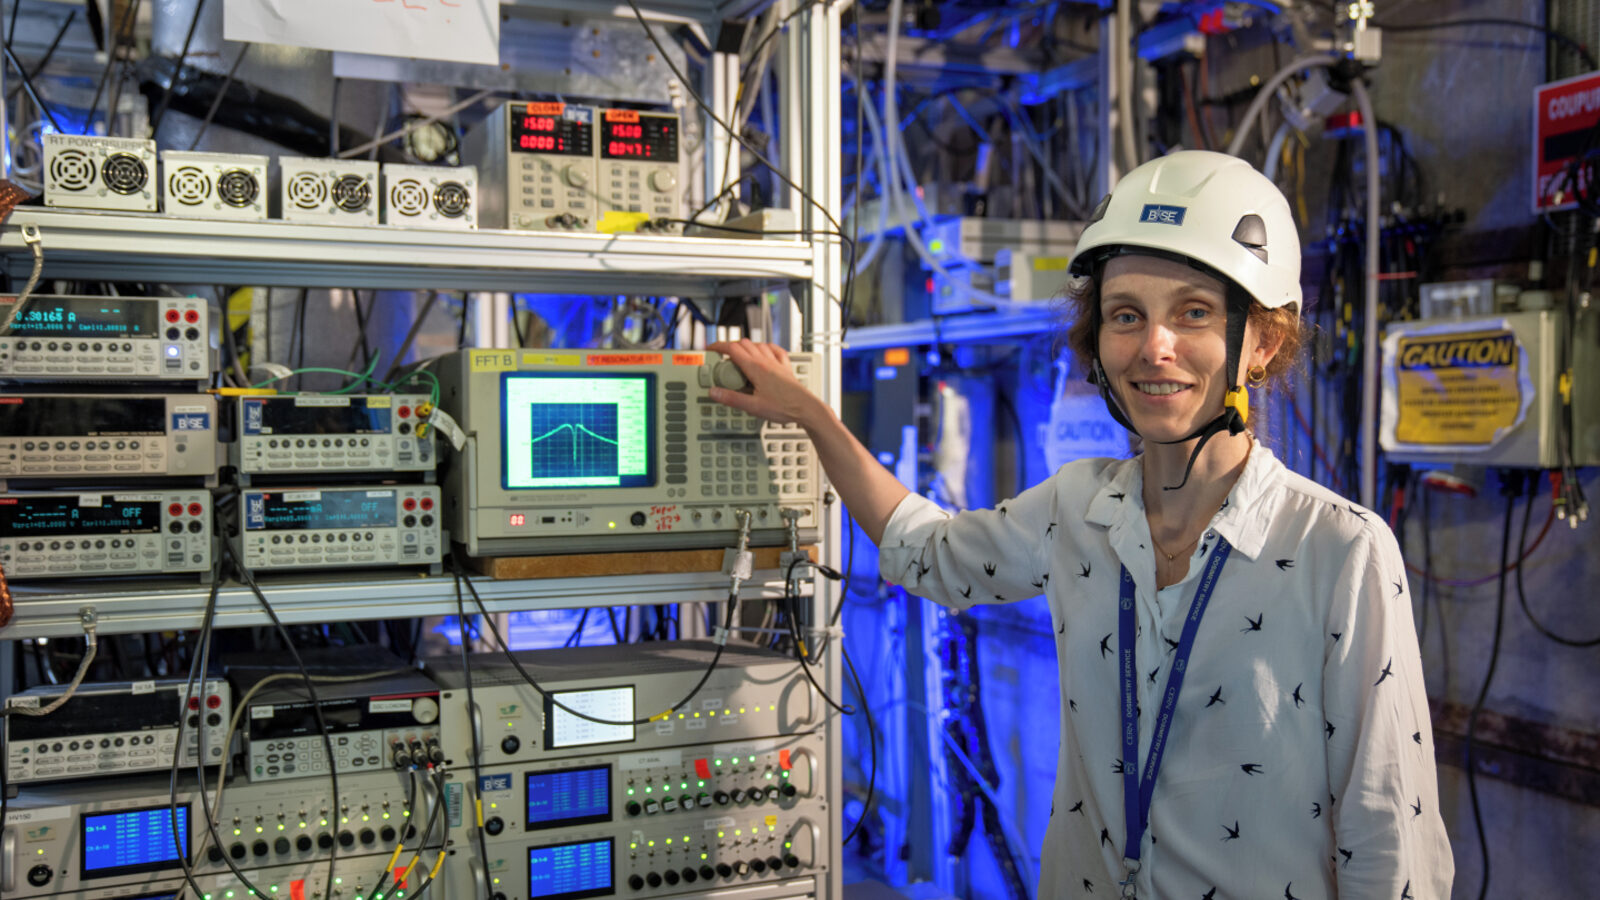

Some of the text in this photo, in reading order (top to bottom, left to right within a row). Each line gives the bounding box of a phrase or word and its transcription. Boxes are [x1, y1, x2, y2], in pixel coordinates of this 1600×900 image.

[475, 355, 512, 366] FFT B
[1403, 338, 1513, 367] CAUTION
[122, 508, 142, 518] OFF
[1203, 555, 1221, 594] DOSIMETRY
[1191, 593, 1205, 622] SERVICE
